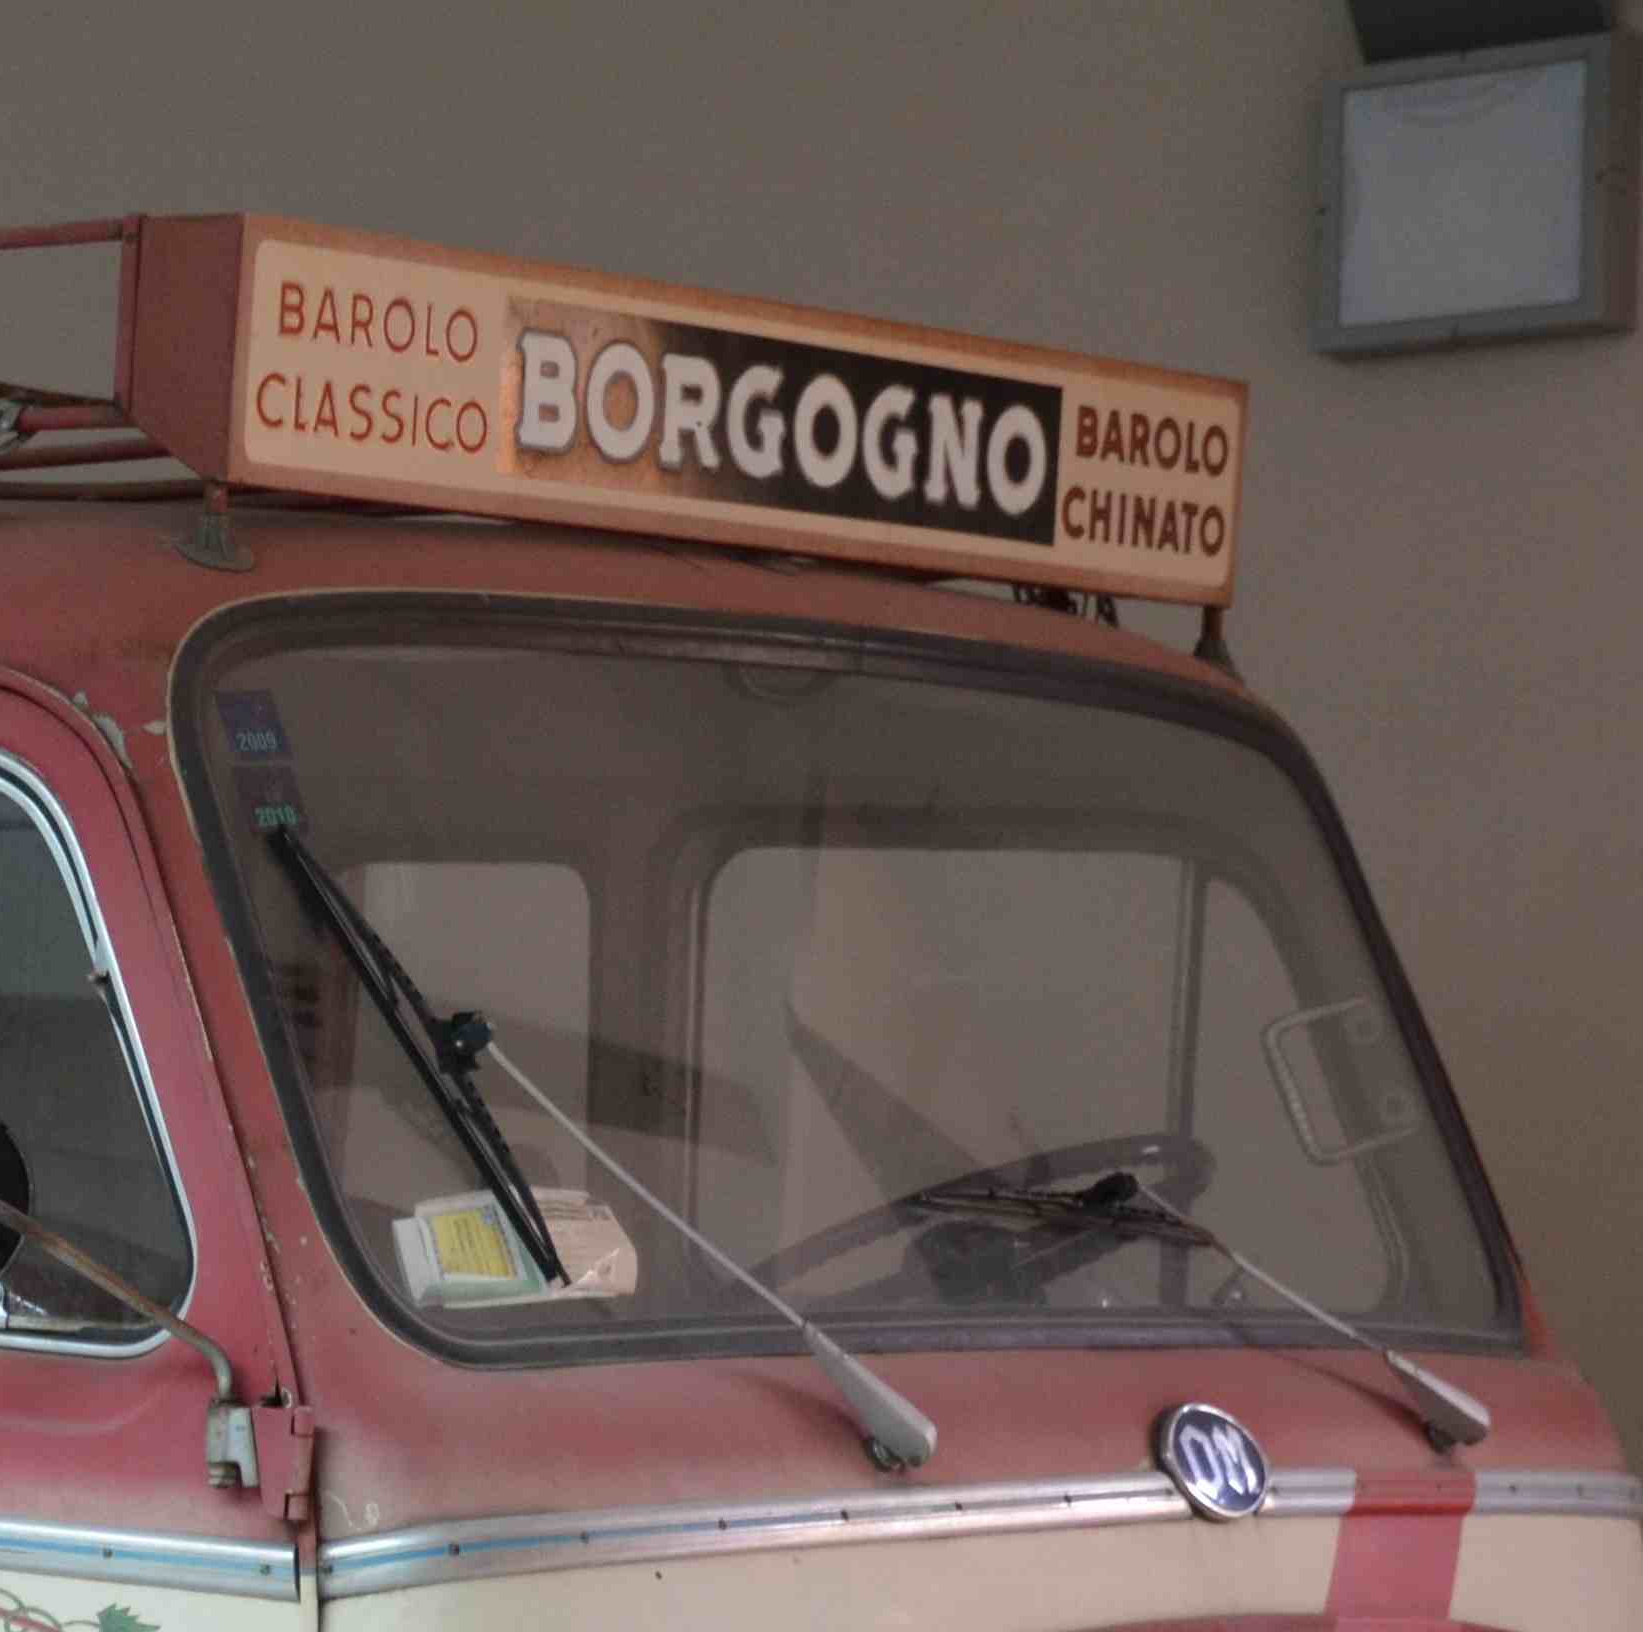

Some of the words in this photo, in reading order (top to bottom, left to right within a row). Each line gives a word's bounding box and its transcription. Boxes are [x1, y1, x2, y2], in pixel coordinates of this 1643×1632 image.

[277, 283, 480, 364] BAROLO
[255, 372, 489, 453] CLASSICO
[516, 327, 1050, 517] BORGOGNO
[1075, 404, 1230, 478] BAROLO
[1061, 487, 1228, 559] CHINATO
